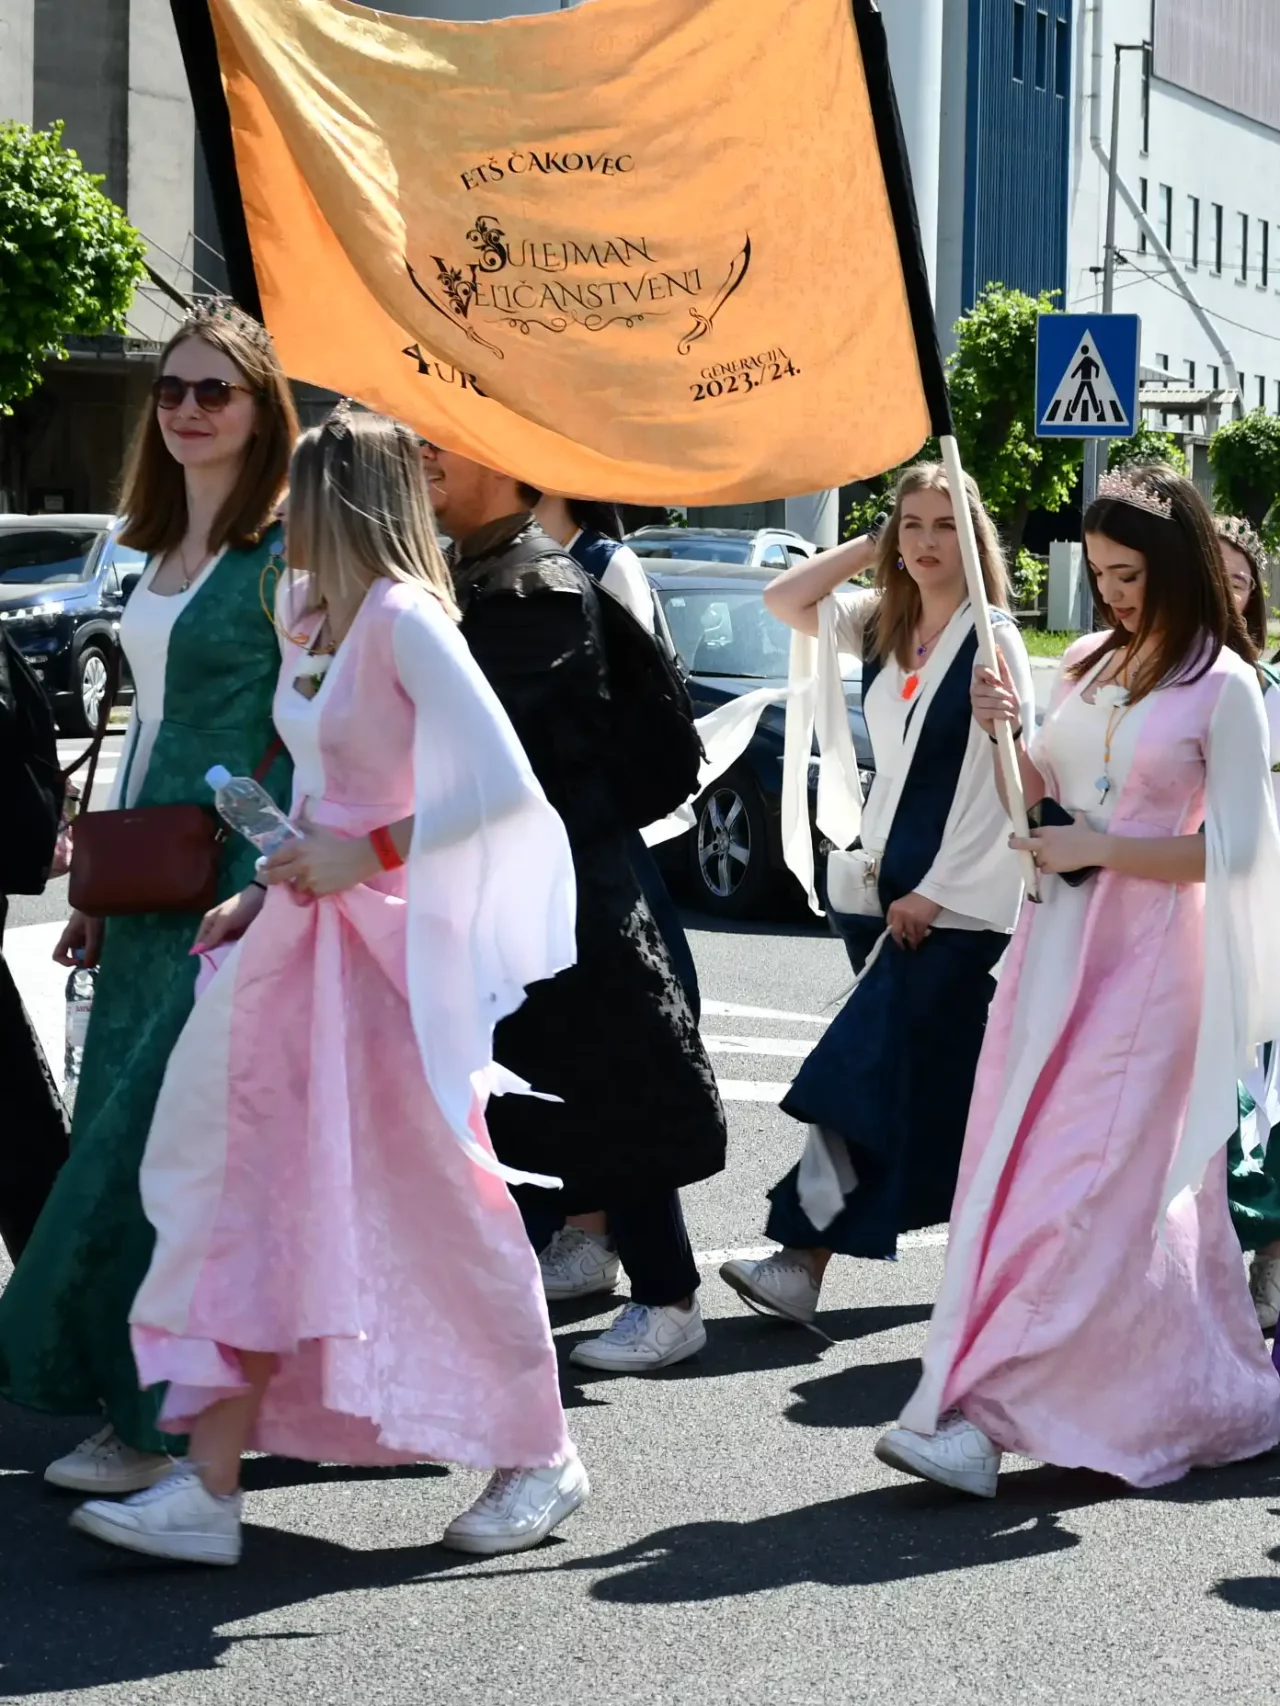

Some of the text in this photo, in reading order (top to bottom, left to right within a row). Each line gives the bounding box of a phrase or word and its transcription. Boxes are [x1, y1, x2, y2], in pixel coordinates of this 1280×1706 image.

[460, 151, 635, 191] ETŠ ČAKOVEC
[466, 215, 658, 273] SULEJMAN
[430, 254, 703, 318] VELIČANSTVENI
[689, 358, 801, 402] 2023./24.
[700, 347, 788, 380] GENERACIJA
